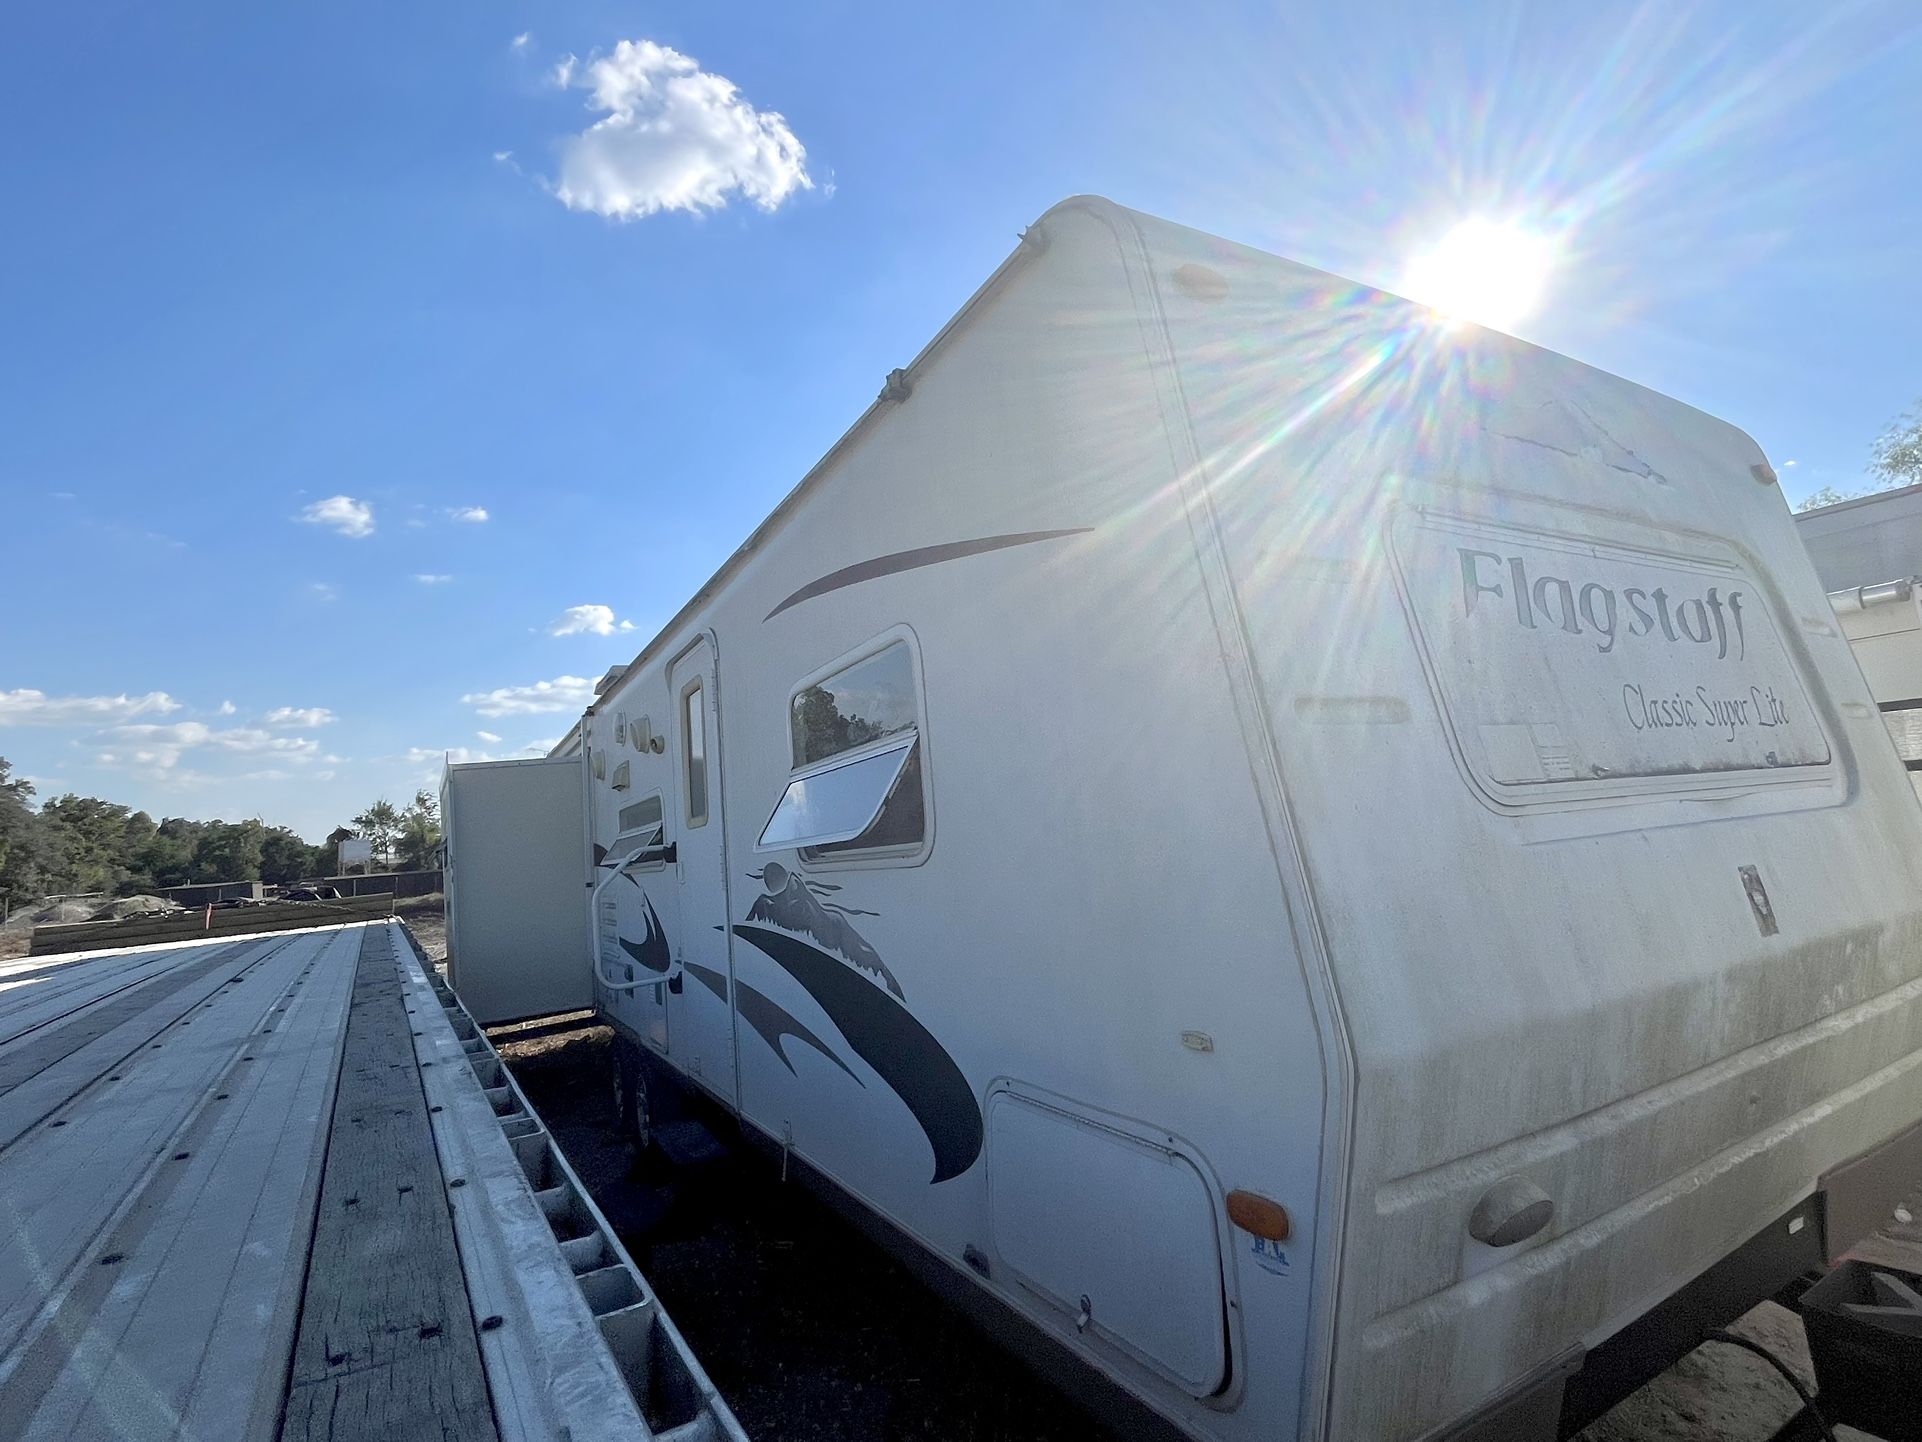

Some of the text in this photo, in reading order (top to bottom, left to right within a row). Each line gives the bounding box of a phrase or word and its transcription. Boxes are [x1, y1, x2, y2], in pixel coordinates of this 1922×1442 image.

[1456, 547, 1744, 661] Flagstaff
[1622, 683, 1790, 743] Classic Super Lite
